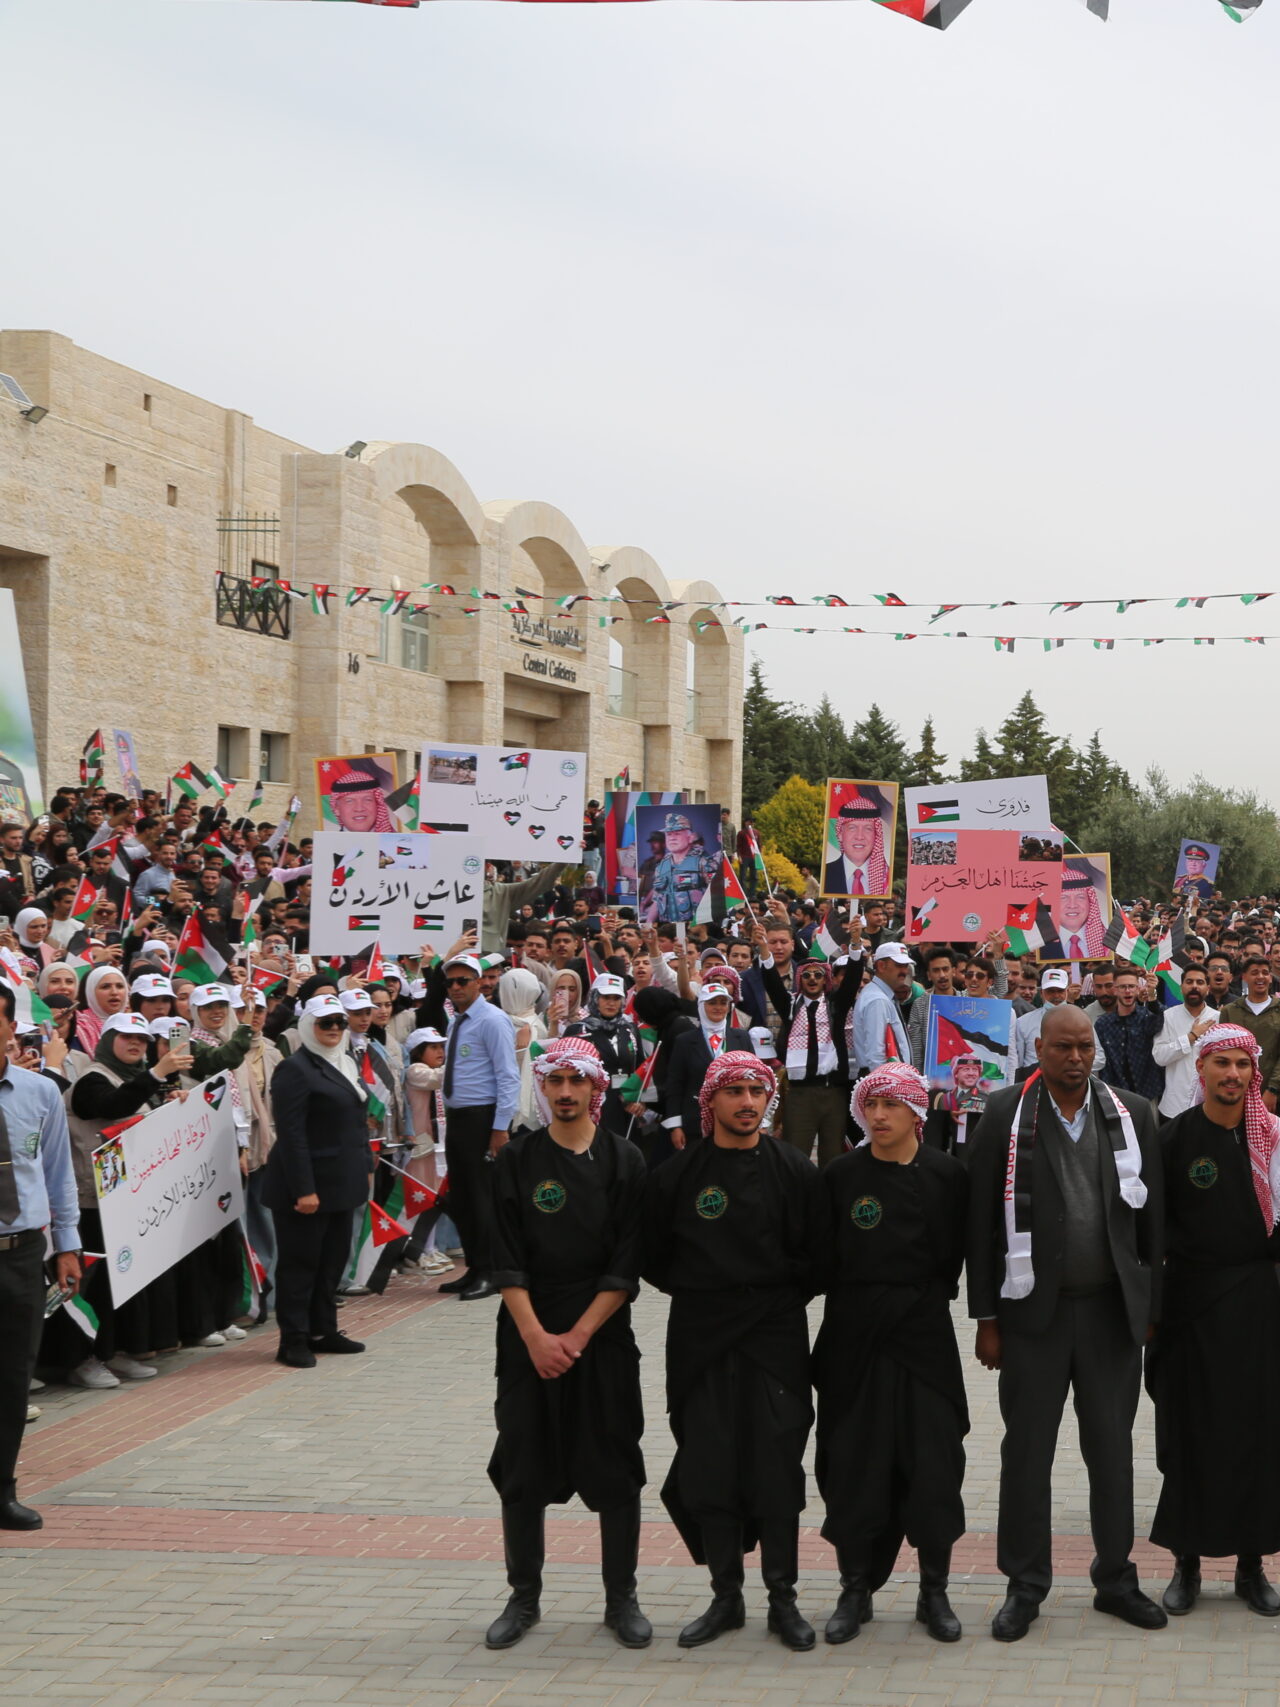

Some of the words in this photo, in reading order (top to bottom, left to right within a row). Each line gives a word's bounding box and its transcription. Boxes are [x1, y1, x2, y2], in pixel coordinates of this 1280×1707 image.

[348, 652, 360, 675] 16
[523, 653, 547, 676] Central
[549, 660, 576, 683] Cafeteria
[506, 793, 529, 807] الله
[921, 868, 976, 892] العزم
[328, 879, 409, 908] الأردن
[413, 878, 475, 910] عاش
